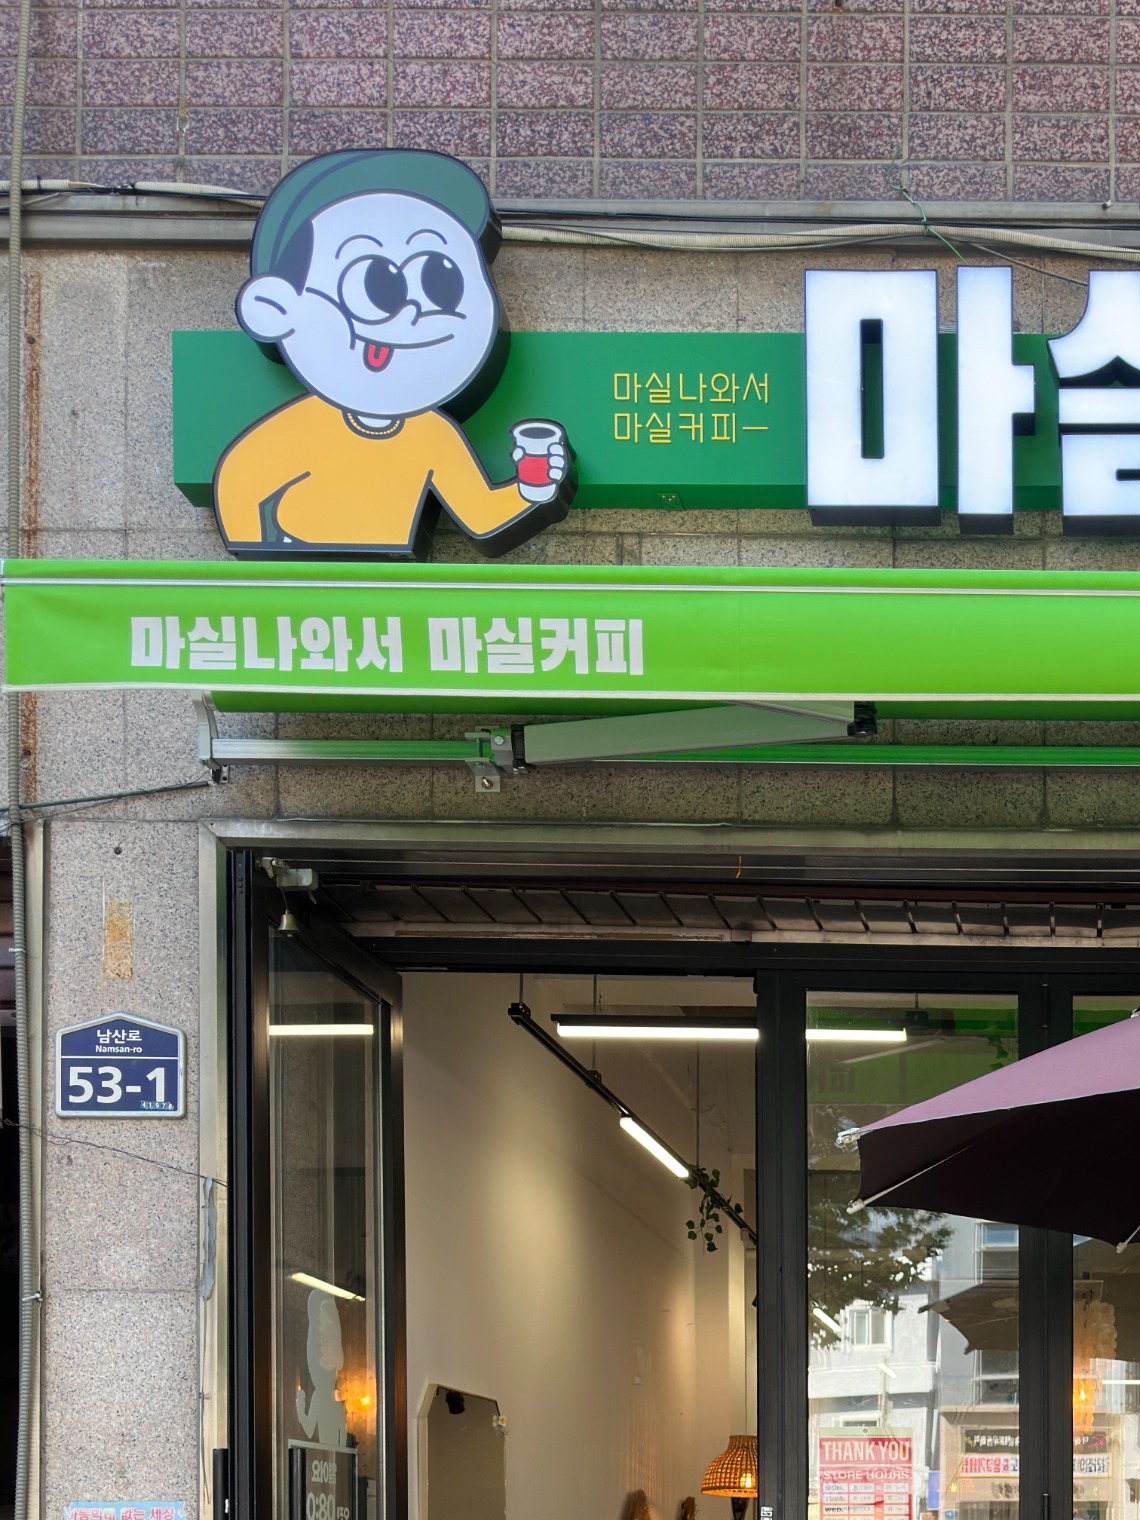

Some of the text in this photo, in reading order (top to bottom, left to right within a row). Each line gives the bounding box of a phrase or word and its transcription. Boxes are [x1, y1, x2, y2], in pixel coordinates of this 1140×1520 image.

[613, 372, 769, 404] 마실나와서
[129, 615, 644, 676] 마실나와서 마실커피
[96, 1028, 143, 1044] 남산로
[95, 1044, 143, 1054] Namsan-ro
[68, 1065, 166, 1104] 53-1
[822, 1440, 910, 1461] THANK YOU
[823, 1470, 910, 1480] STORE HOURS
[120, 1508, 145, 1520] 없는
[149, 1507, 175, 1520] 세상
